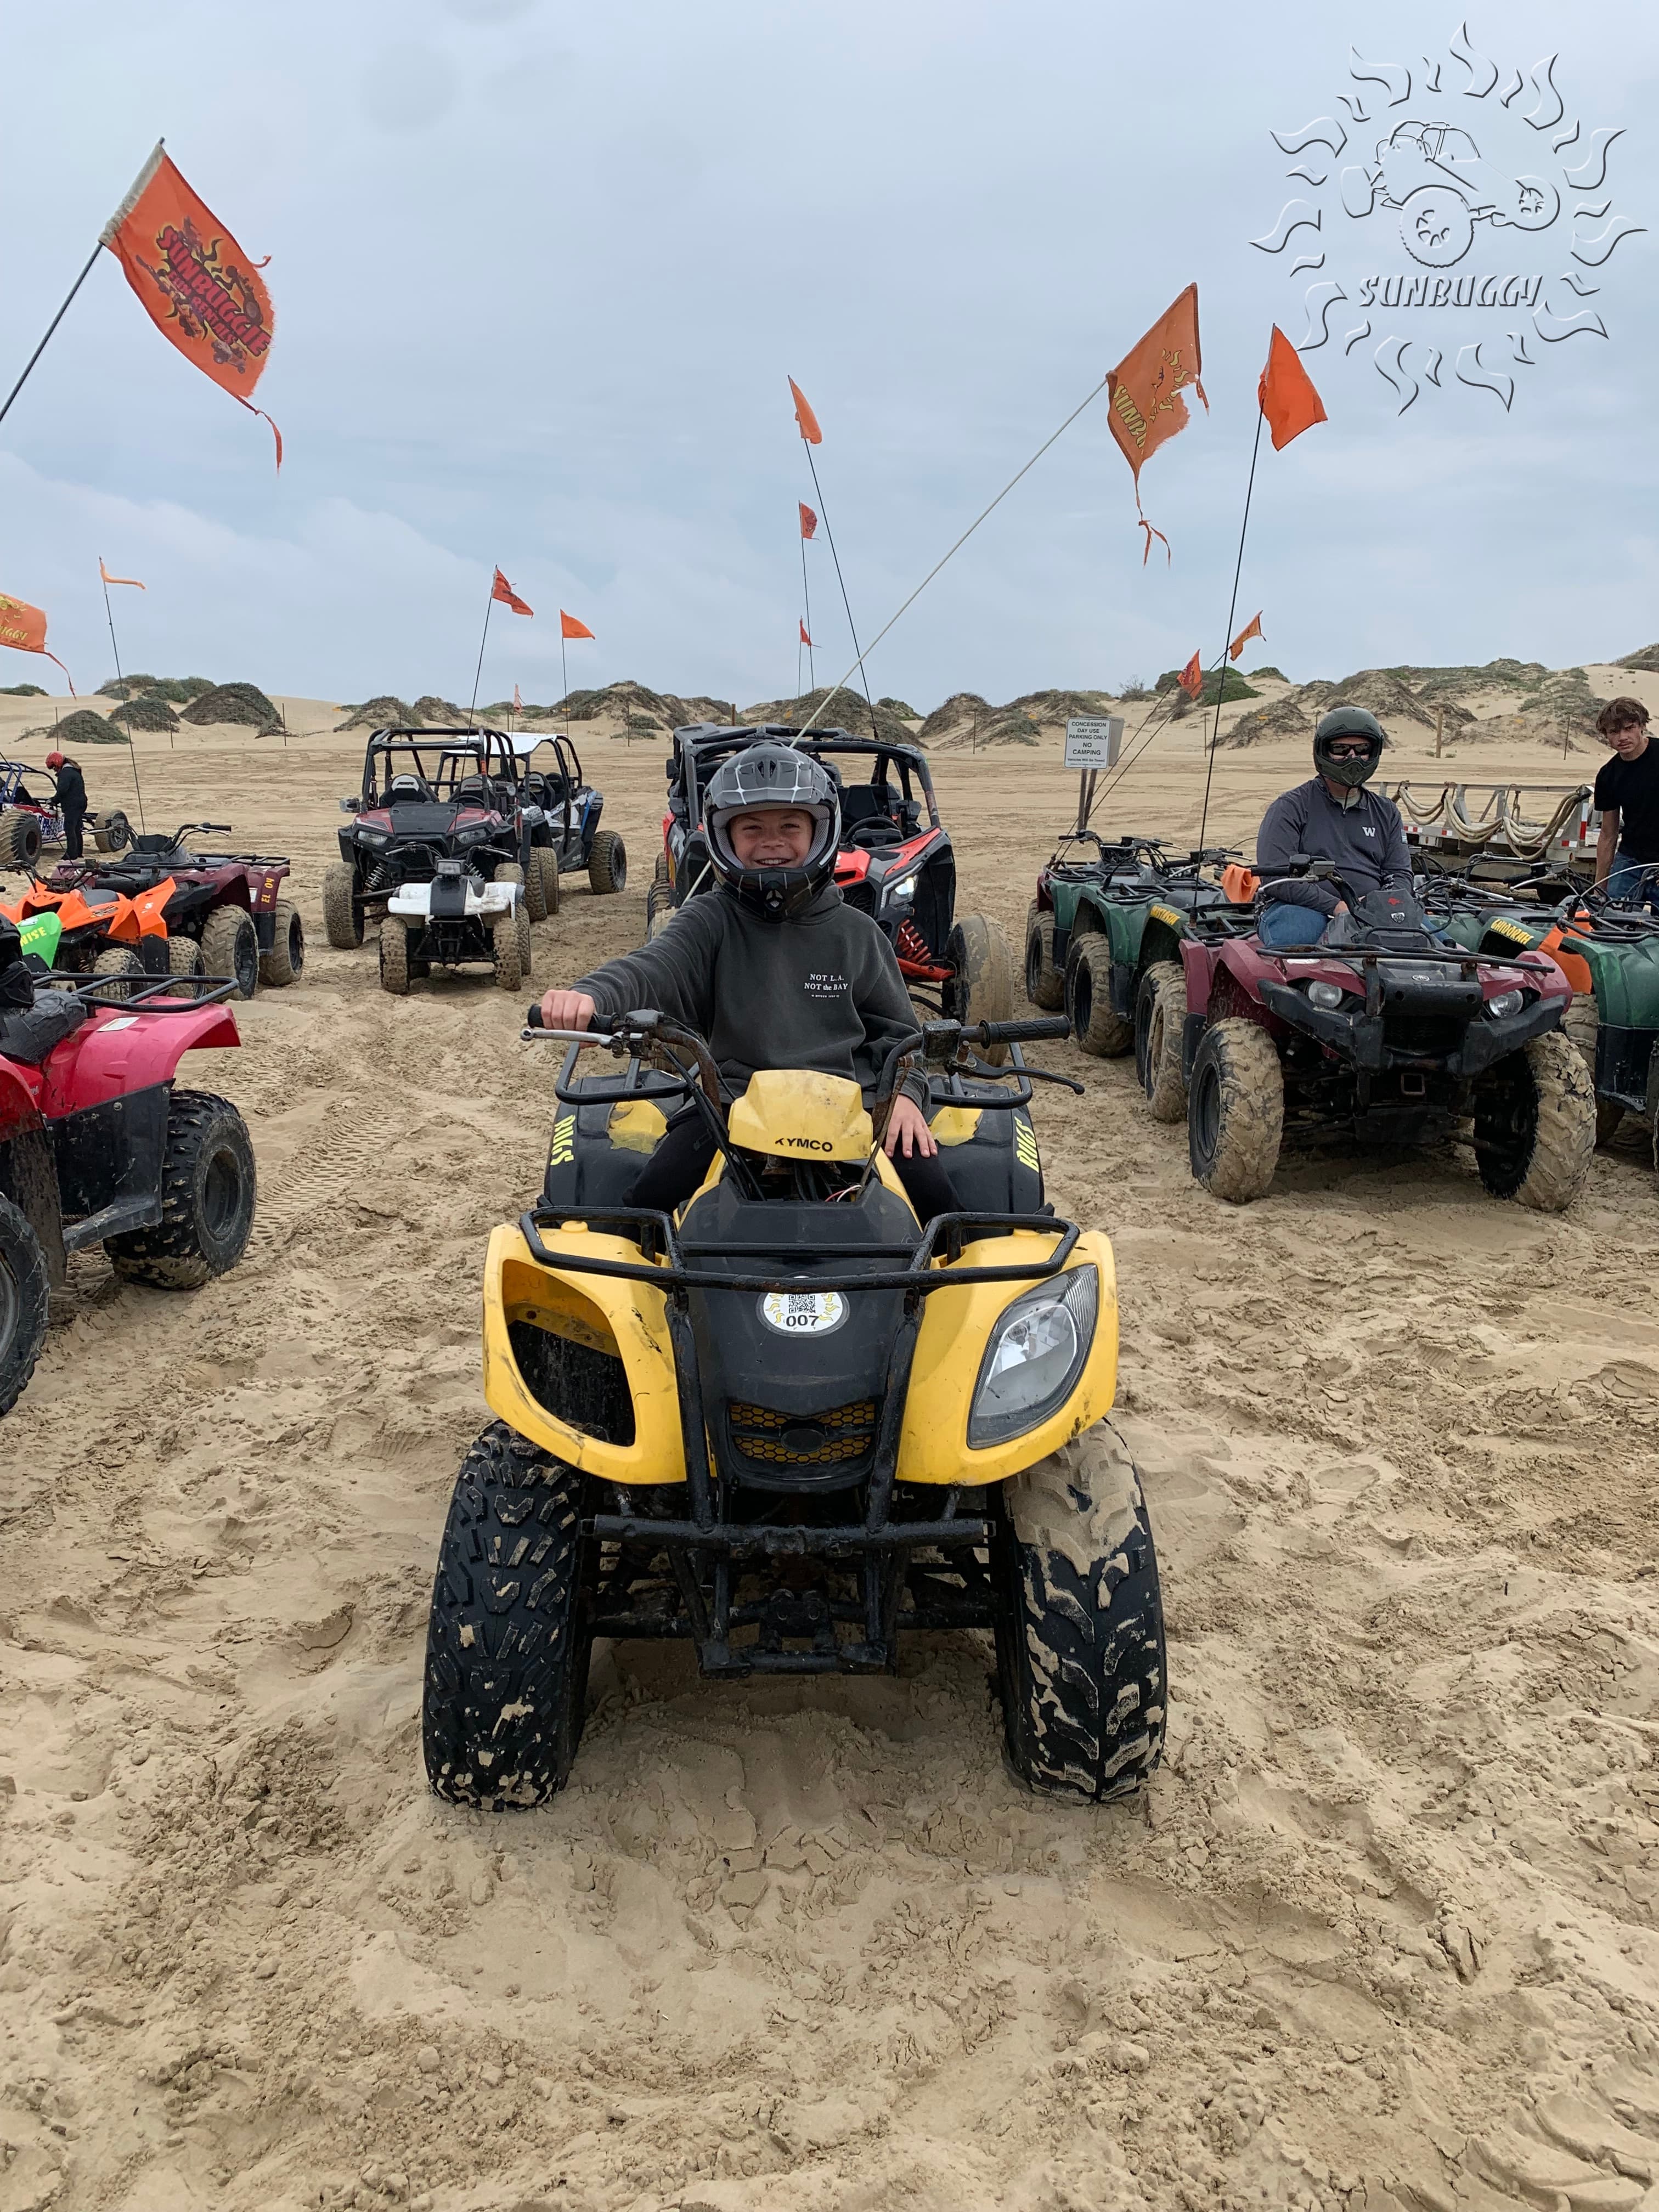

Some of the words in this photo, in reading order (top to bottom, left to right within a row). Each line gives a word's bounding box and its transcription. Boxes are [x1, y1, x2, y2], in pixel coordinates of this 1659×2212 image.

[191, 296, 237, 345] RENTALS
[1113, 384, 1147, 449] SUNBU
[1362, 827, 1376, 837] W
[1491, 919, 1534, 945] GHIDORAH
[775, 1138, 833, 1152] KYMCO
[786, 1314, 819, 1327] 007
